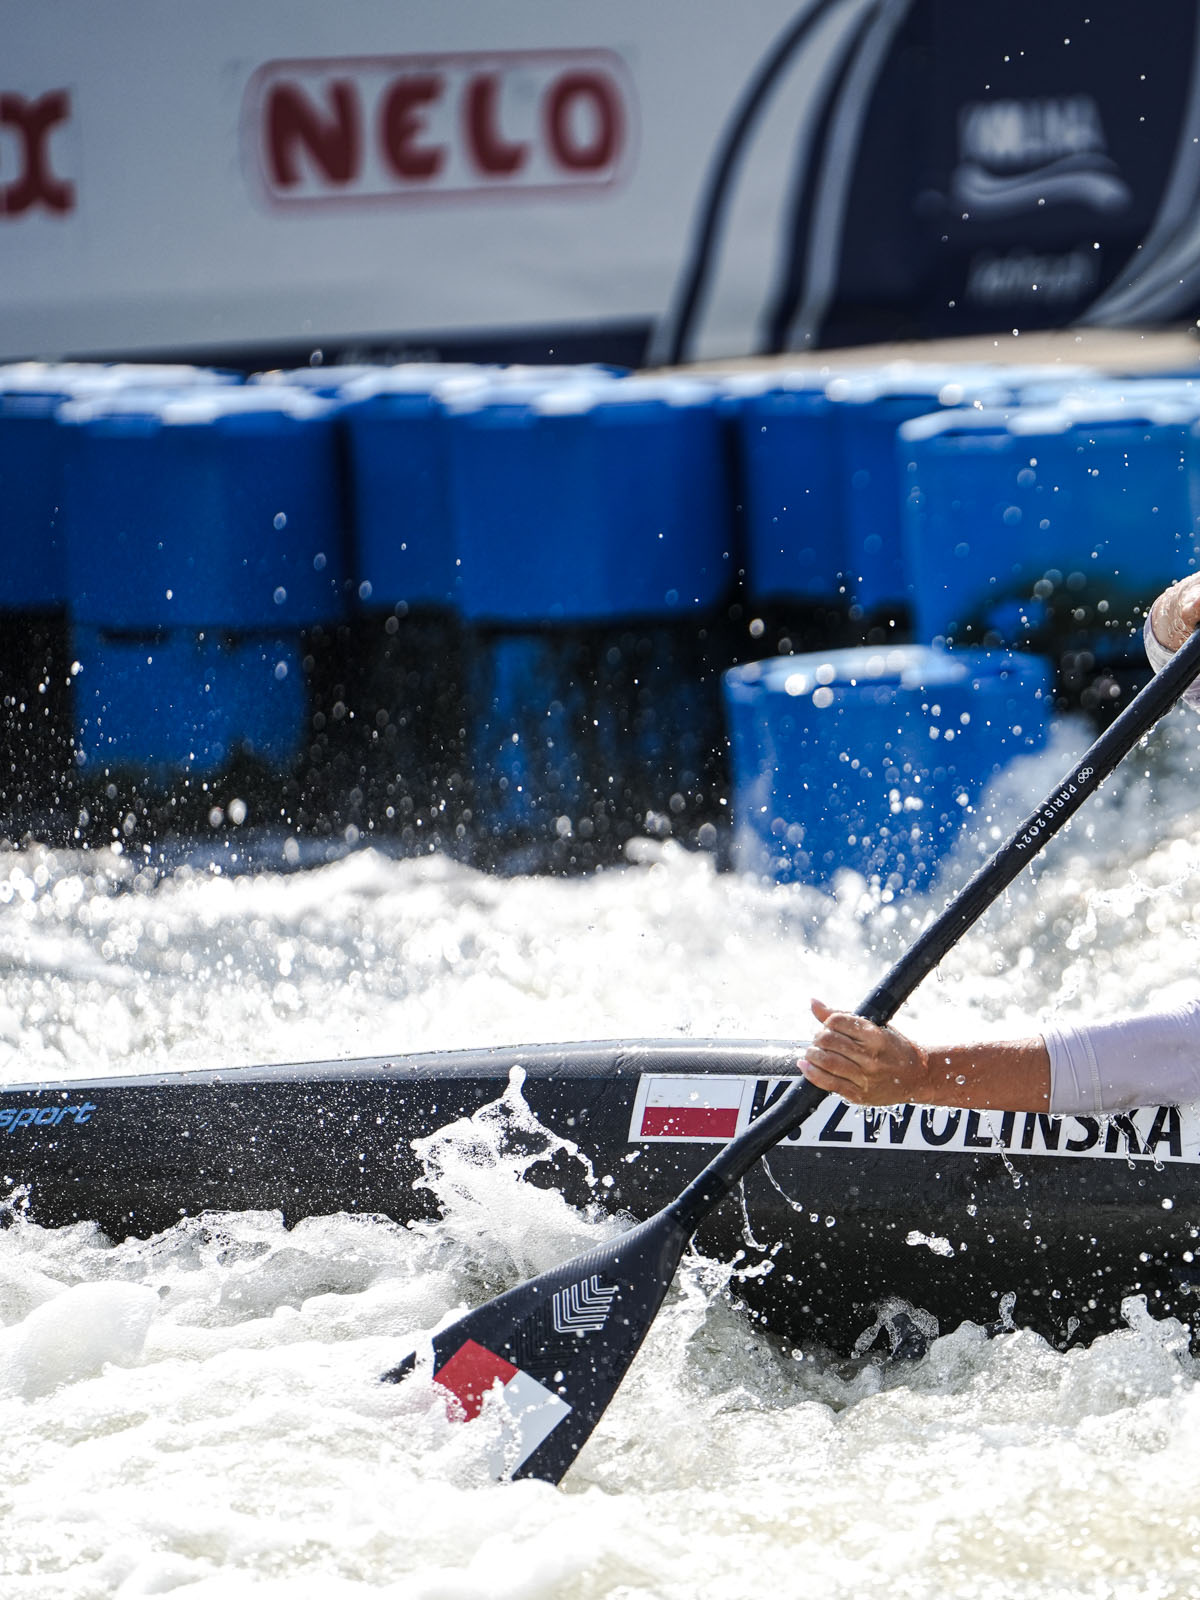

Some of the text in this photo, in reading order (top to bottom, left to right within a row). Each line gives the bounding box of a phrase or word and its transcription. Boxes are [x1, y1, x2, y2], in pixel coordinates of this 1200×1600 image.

[262, 68, 626, 188] NELO
[1015, 784, 1077, 850] PARIS 2024
